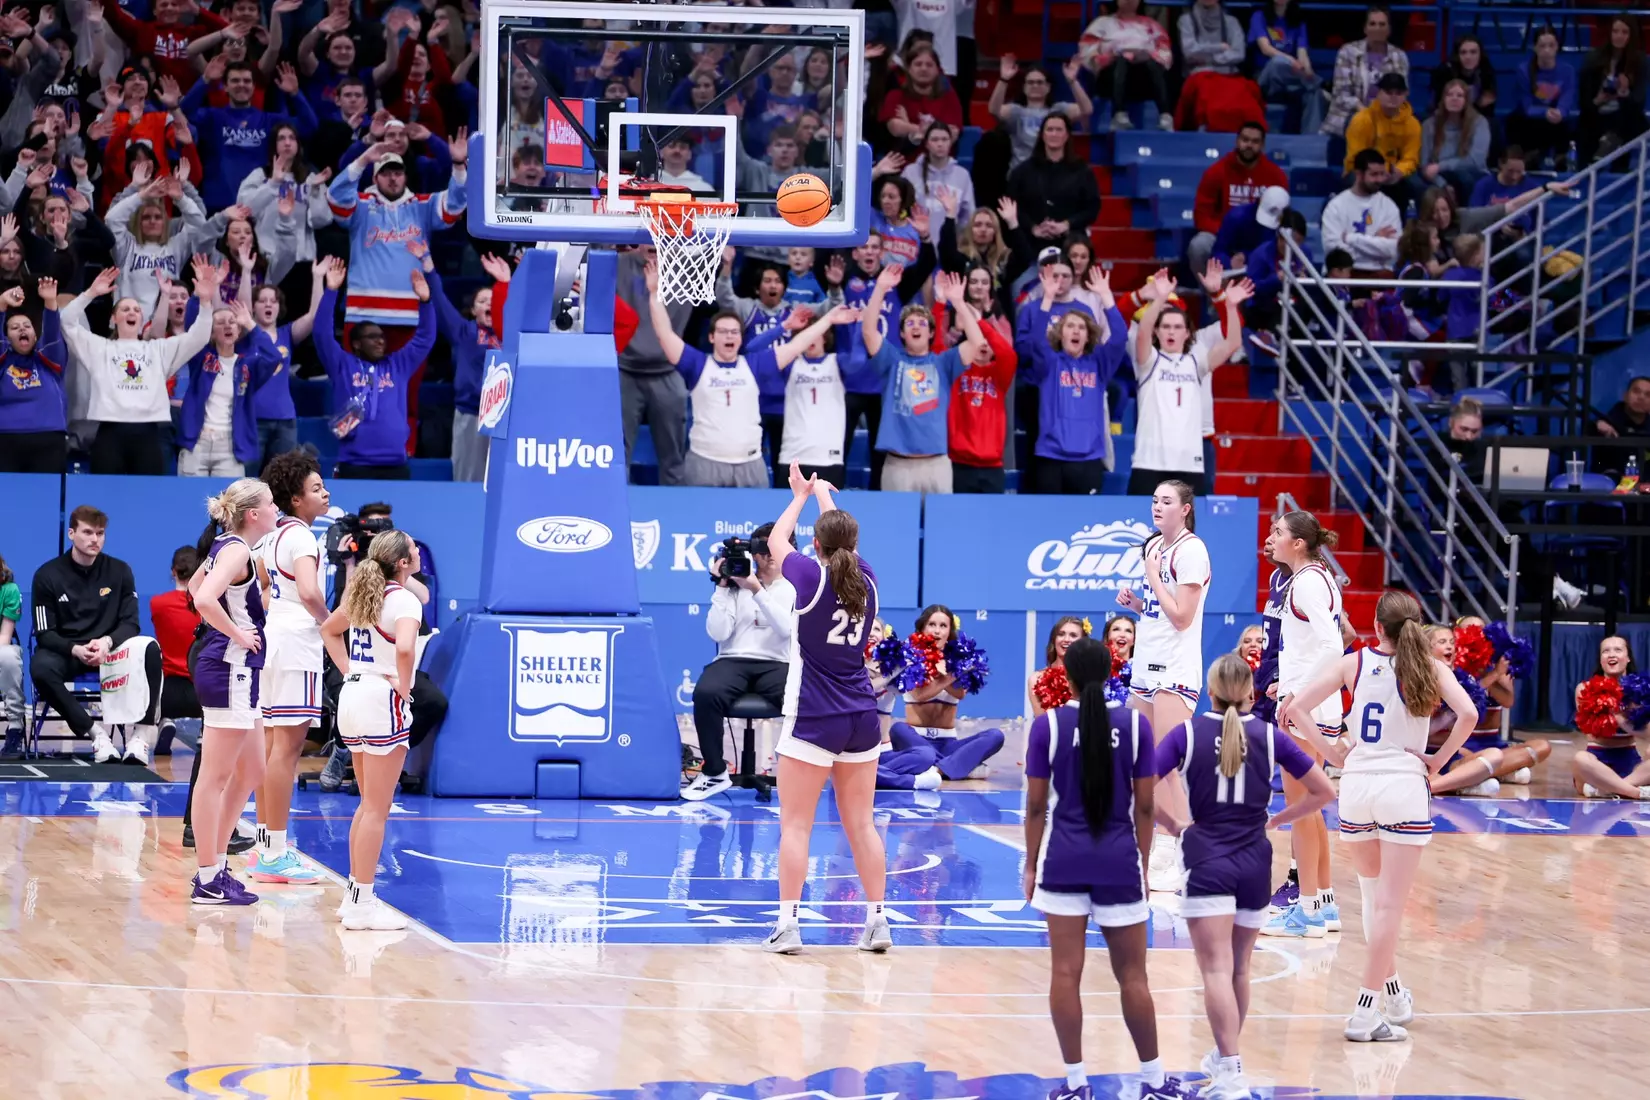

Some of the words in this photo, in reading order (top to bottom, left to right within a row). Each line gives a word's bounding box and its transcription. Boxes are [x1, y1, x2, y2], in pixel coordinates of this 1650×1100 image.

[222, 126, 267, 142] KANSAS
[784, 178, 810, 190] NCAA
[496, 215, 533, 224] SPALDING
[130, 253, 177, 274] JAYHAWKS
[724, 389, 731, 407] 1
[810, 387, 817, 405] 1
[1174, 386, 1182, 407] 1
[537, 521, 597, 547] Ford
[1026, 540, 1146, 578] Club
[449, 599, 458, 611] 8
[826, 608, 866, 646] 23
[350, 627, 375, 664] 22
[519, 655, 603, 672] SHELTER
[519, 672, 602, 685] INSURANCE
[1360, 701, 1384, 744] 6
